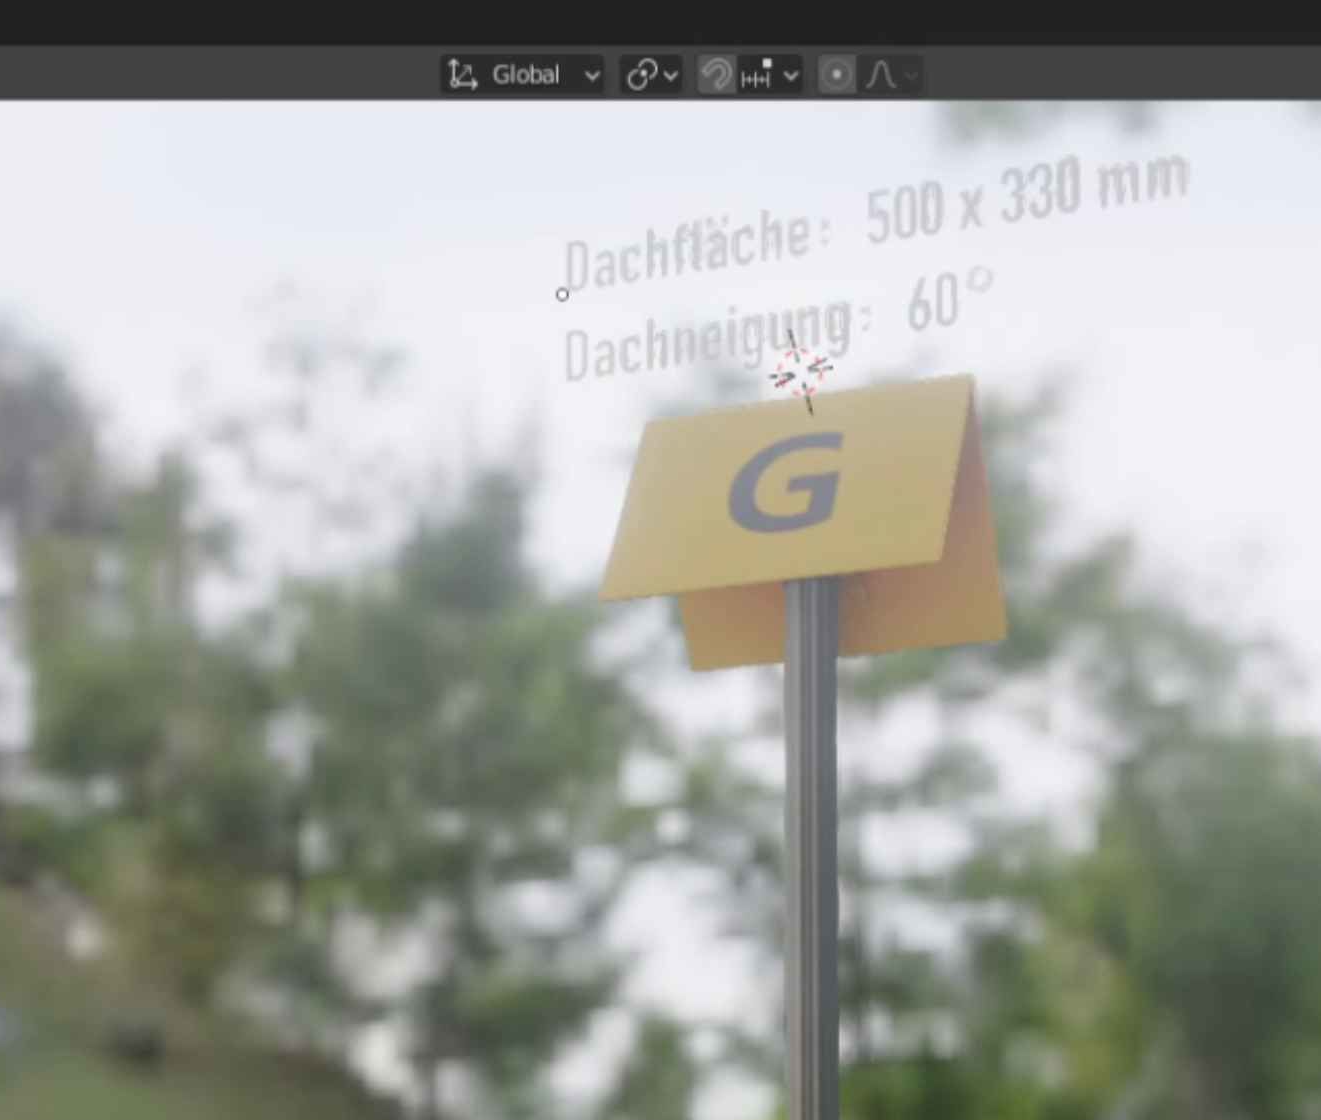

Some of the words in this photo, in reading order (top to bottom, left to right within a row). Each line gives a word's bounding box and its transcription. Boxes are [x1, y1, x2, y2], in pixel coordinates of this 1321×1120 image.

[492, 64, 560, 85] Global
[565, 208, 832, 294] Dachfläche:
[867, 180, 944, 244] 500
[1001, 155, 1082, 223] 330
[1097, 152, 1191, 208] mm
[728, 431, 845, 535] G
